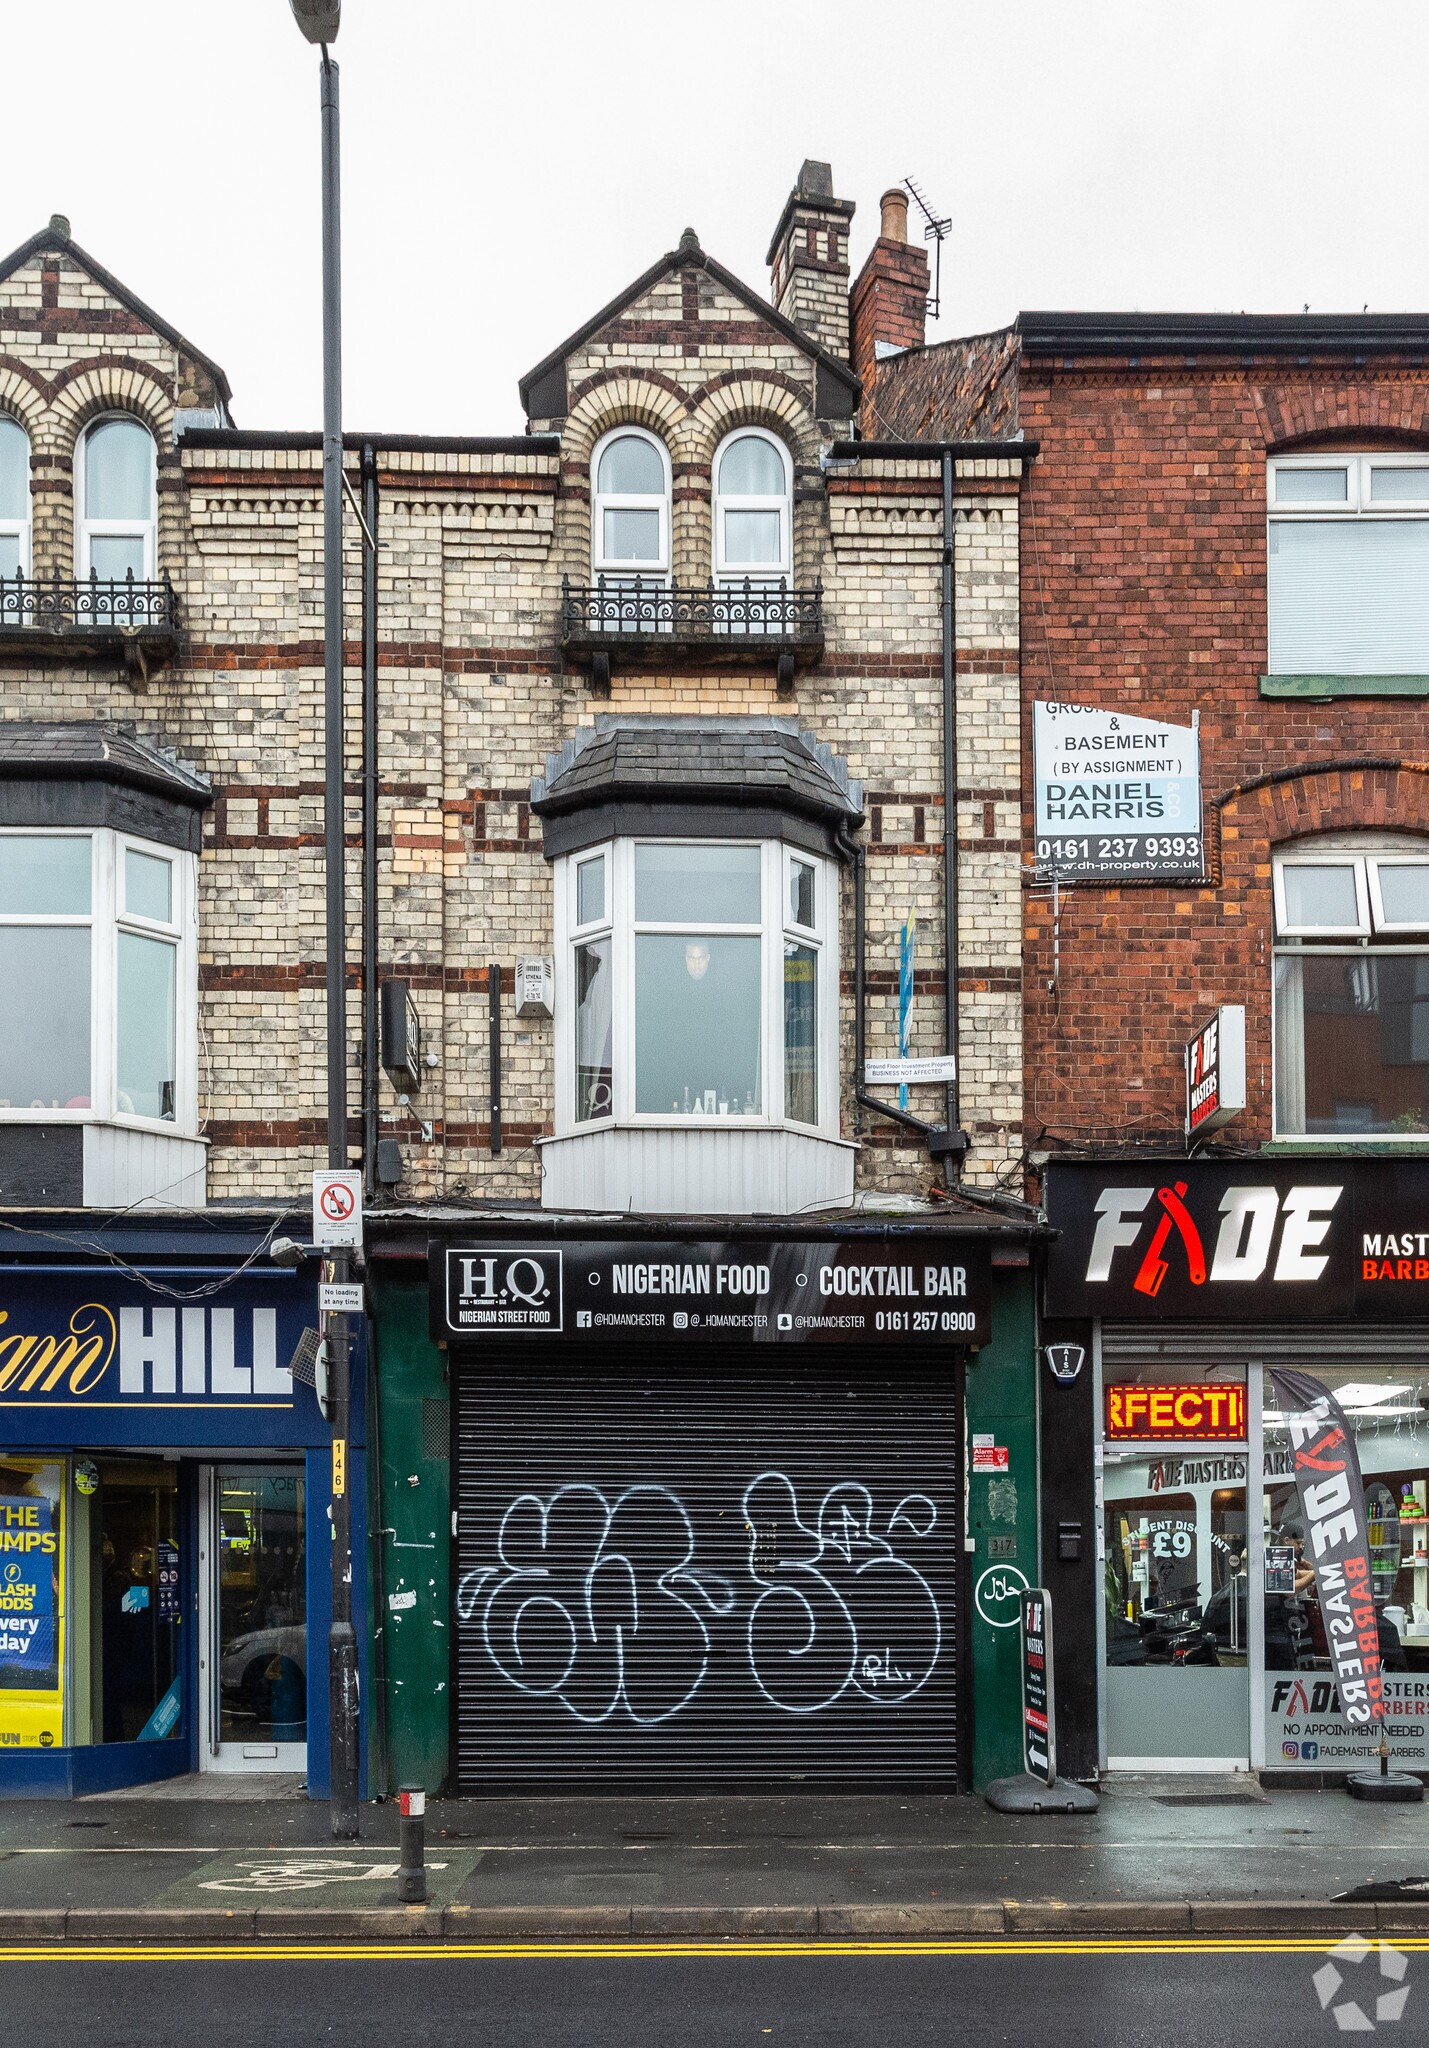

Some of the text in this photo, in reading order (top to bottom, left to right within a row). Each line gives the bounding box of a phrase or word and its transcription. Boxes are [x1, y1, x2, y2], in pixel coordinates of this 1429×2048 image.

[1046, 701, 1105, 713] GRO
[1110, 717, 1120, 730] &
[1065, 734, 1169, 750] BASEMENT
[1046, 783, 1162, 801] DANIEL
[1046, 801, 1164, 820] HARRIS
[1038, 837, 1199, 859] 0161 237 9393
[1038, 859, 1200, 871] ww.dh-property.co.uk
[1191, 1070, 1218, 1111] MASTERS
[1191, 1091, 1218, 1129] BARBERS
[612, 1264, 967, 1296] NIGERIAN FOOD COCKTAIL BAR
[459, 1310, 551, 1323] NIGERIAN STREET FOOD
[875, 1311, 909, 1331] 0161
[913, 1312, 938, 1331] 257
[941, 1312, 976, 1331] 0900
[0, 1303, 294, 1394] am HILL
[1110, 1393, 1242, 1427] RFECTI
[1184, 1459, 1245, 1485] MASTERS
[0, 1531, 56, 1553] MPS
[992, 1540, 1012, 1551] 317
[1153, 1531, 1192, 1558] £9
[0, 1597, 33, 1611] DDS
[0, 1733, 20, 1744] UN
[1283, 1724, 1300, 1736] NO
[1382, 1725, 1425, 1737] NEEDED
